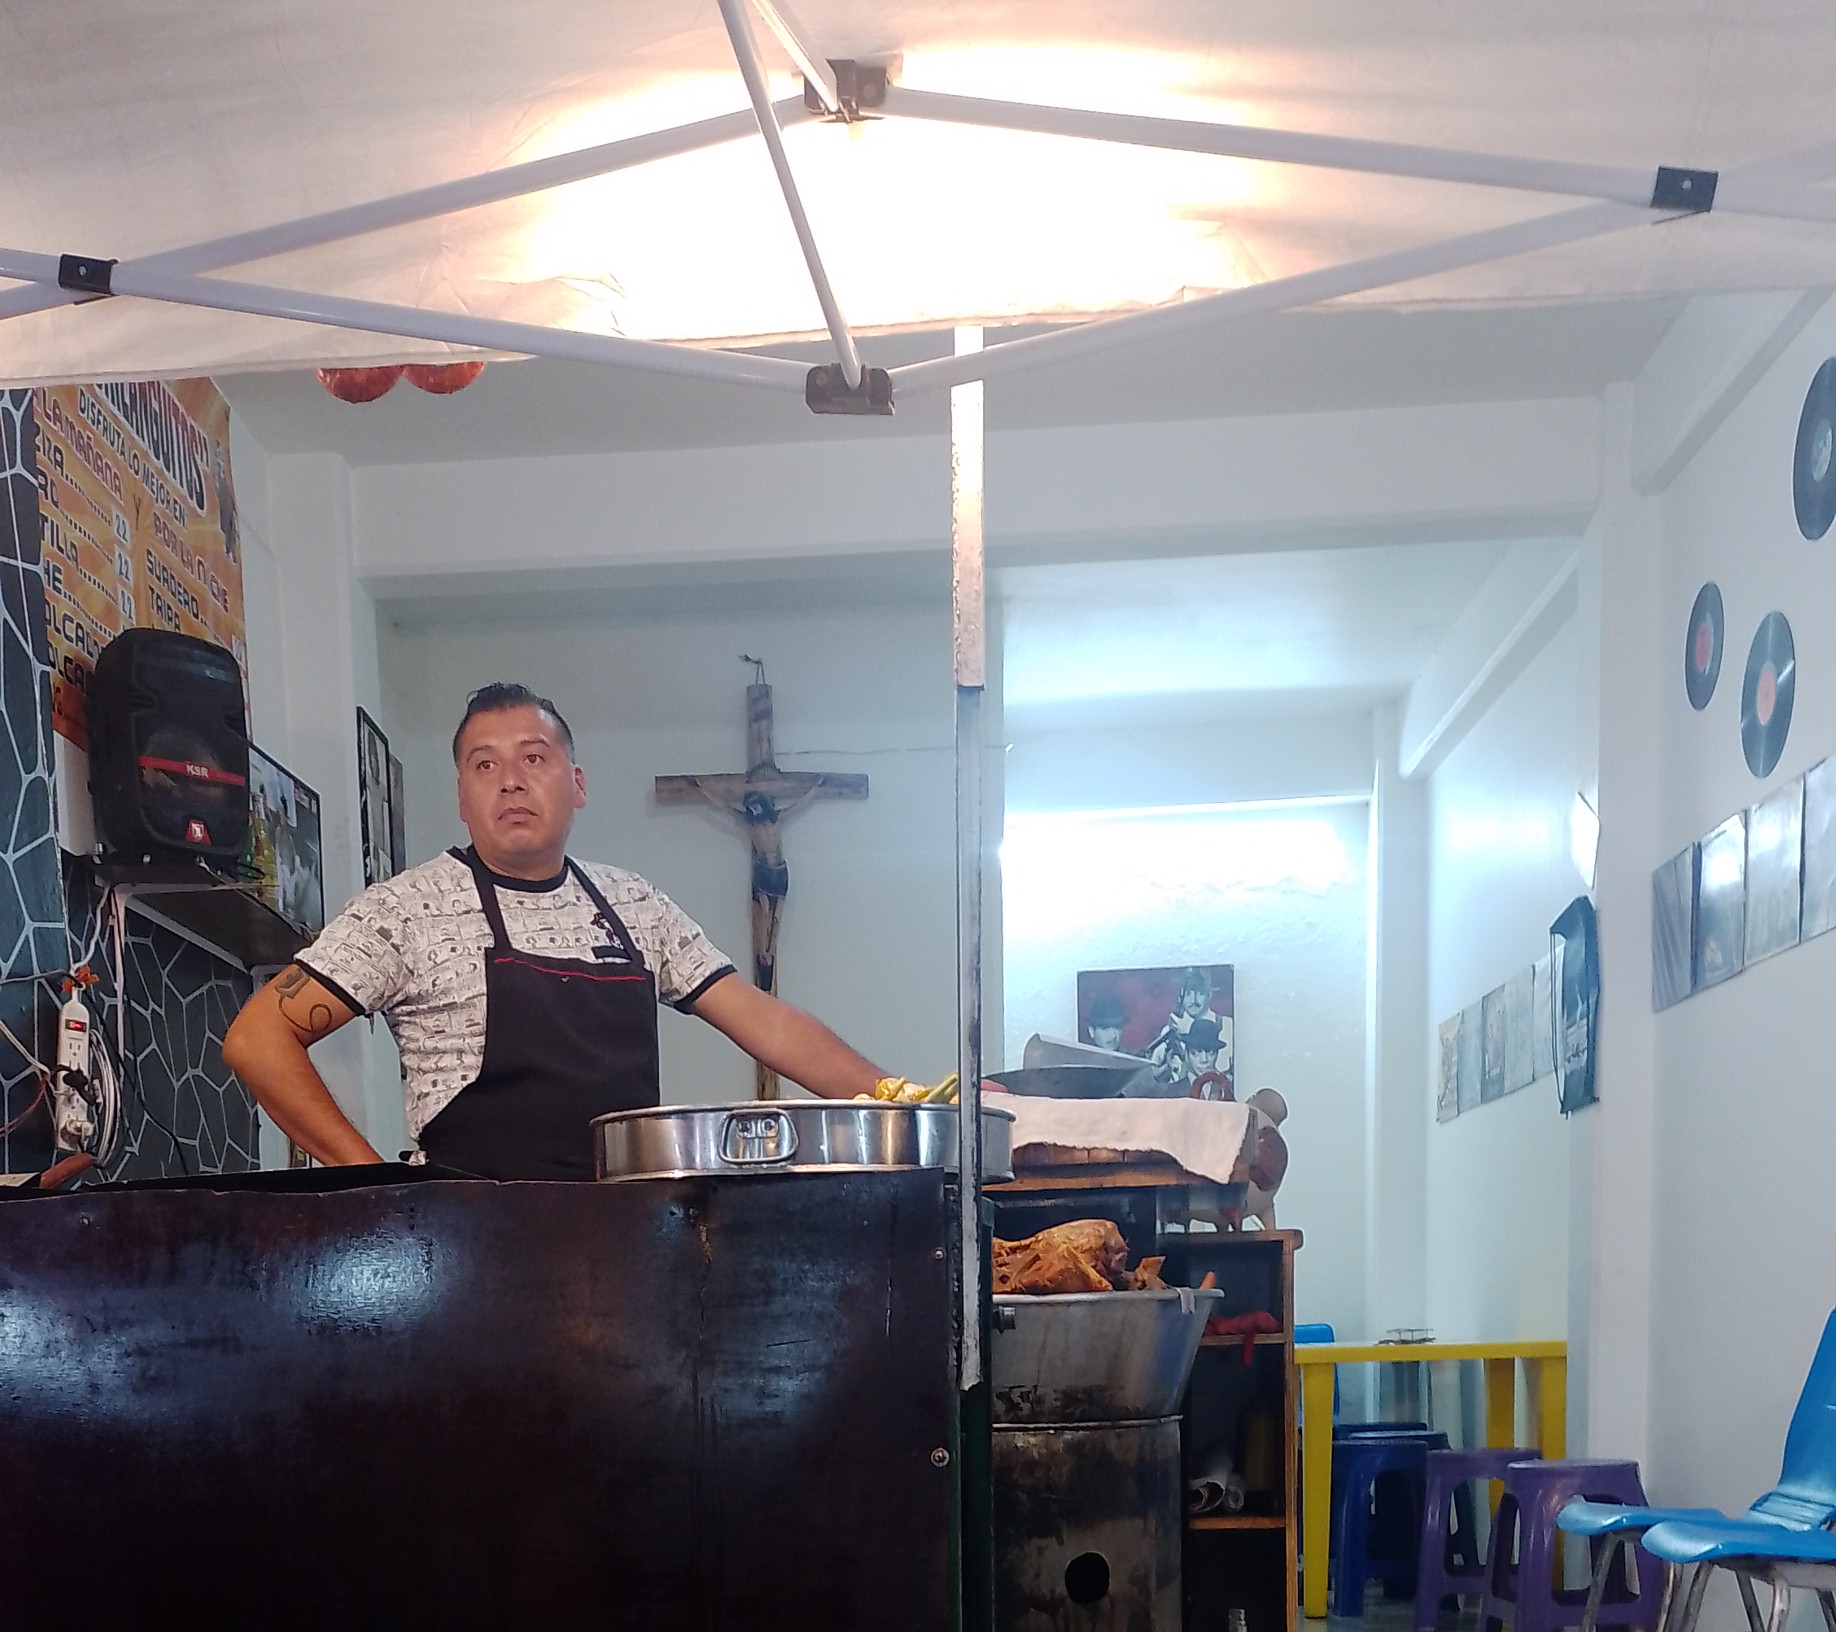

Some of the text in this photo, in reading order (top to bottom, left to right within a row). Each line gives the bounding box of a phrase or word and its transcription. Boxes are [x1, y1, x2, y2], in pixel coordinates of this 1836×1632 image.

[79, 387, 126, 460] DISFRUTA
[142, 463, 172, 512] MEJOR
[115, 513, 129, 543] 22
[153, 511, 178, 556] POR
[186, 764, 209, 778] KSR
